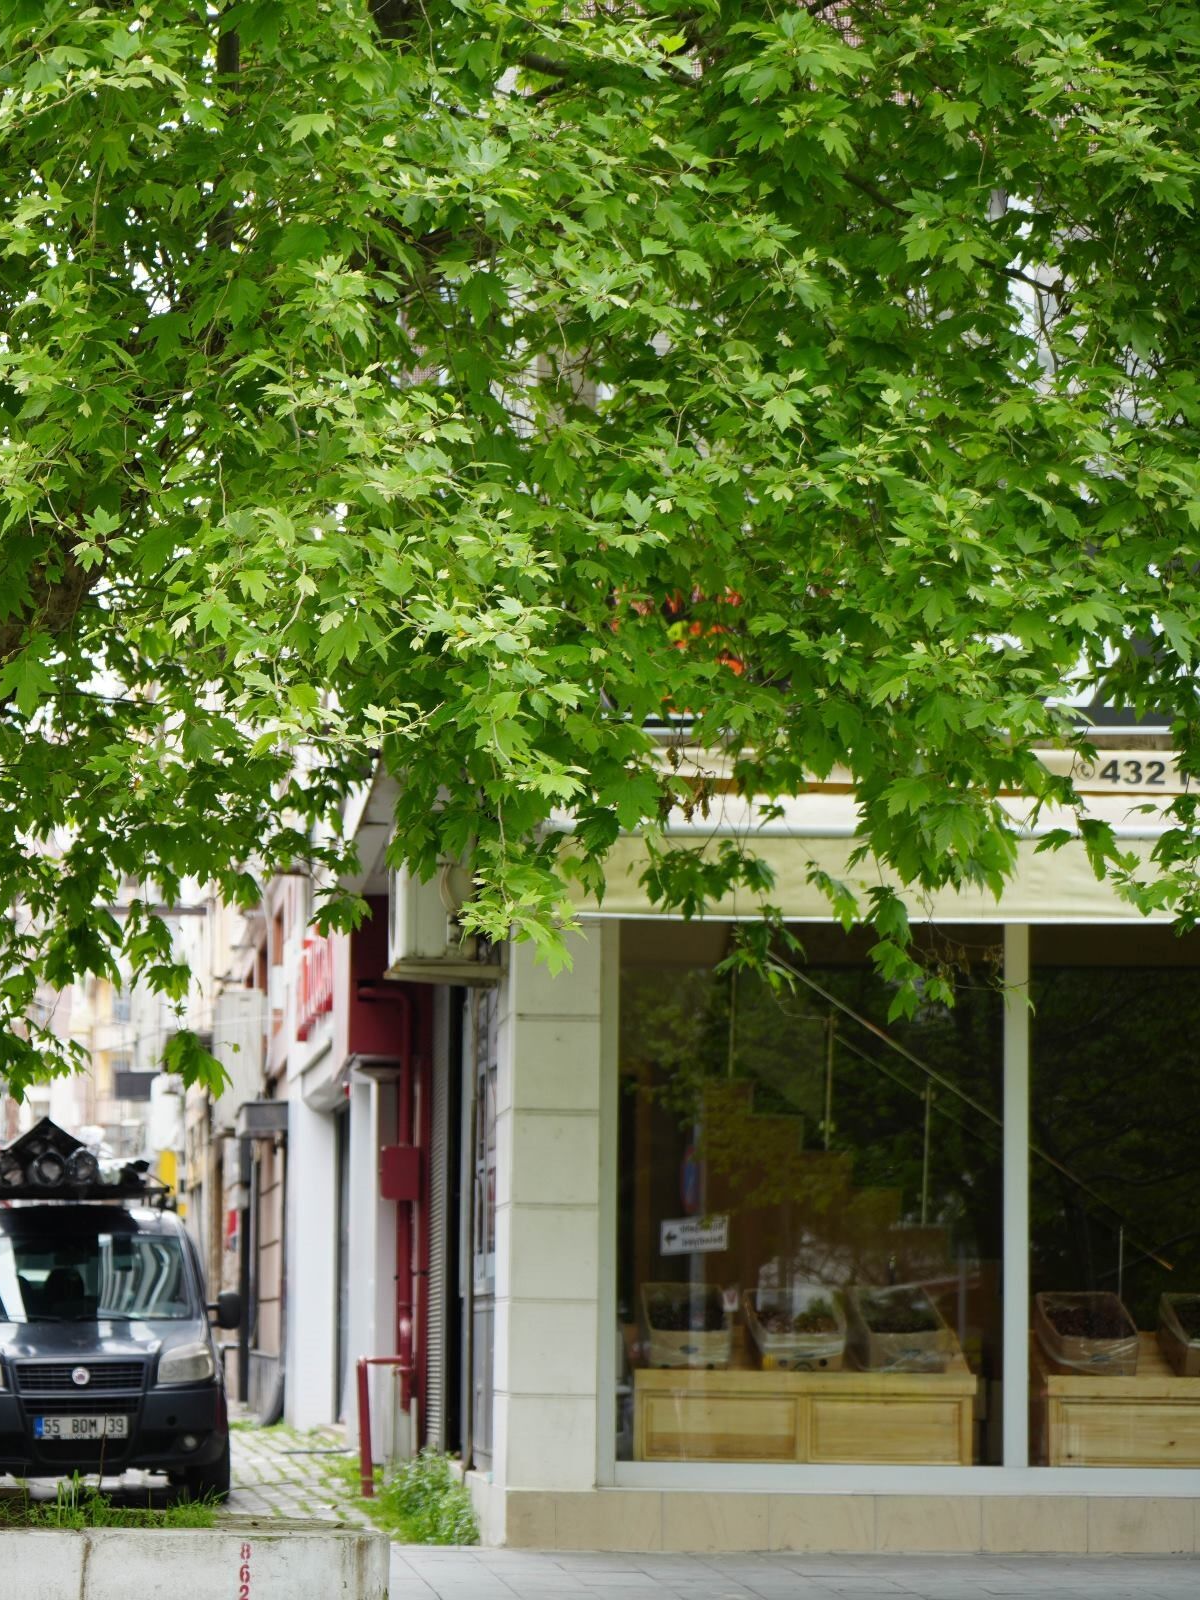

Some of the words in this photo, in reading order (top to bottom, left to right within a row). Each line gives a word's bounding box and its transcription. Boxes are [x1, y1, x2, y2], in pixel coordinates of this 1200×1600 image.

[1099, 760, 1166, 785] 432
[44, 1418, 60, 1434] 55
[107, 1418, 124, 1433] 39
